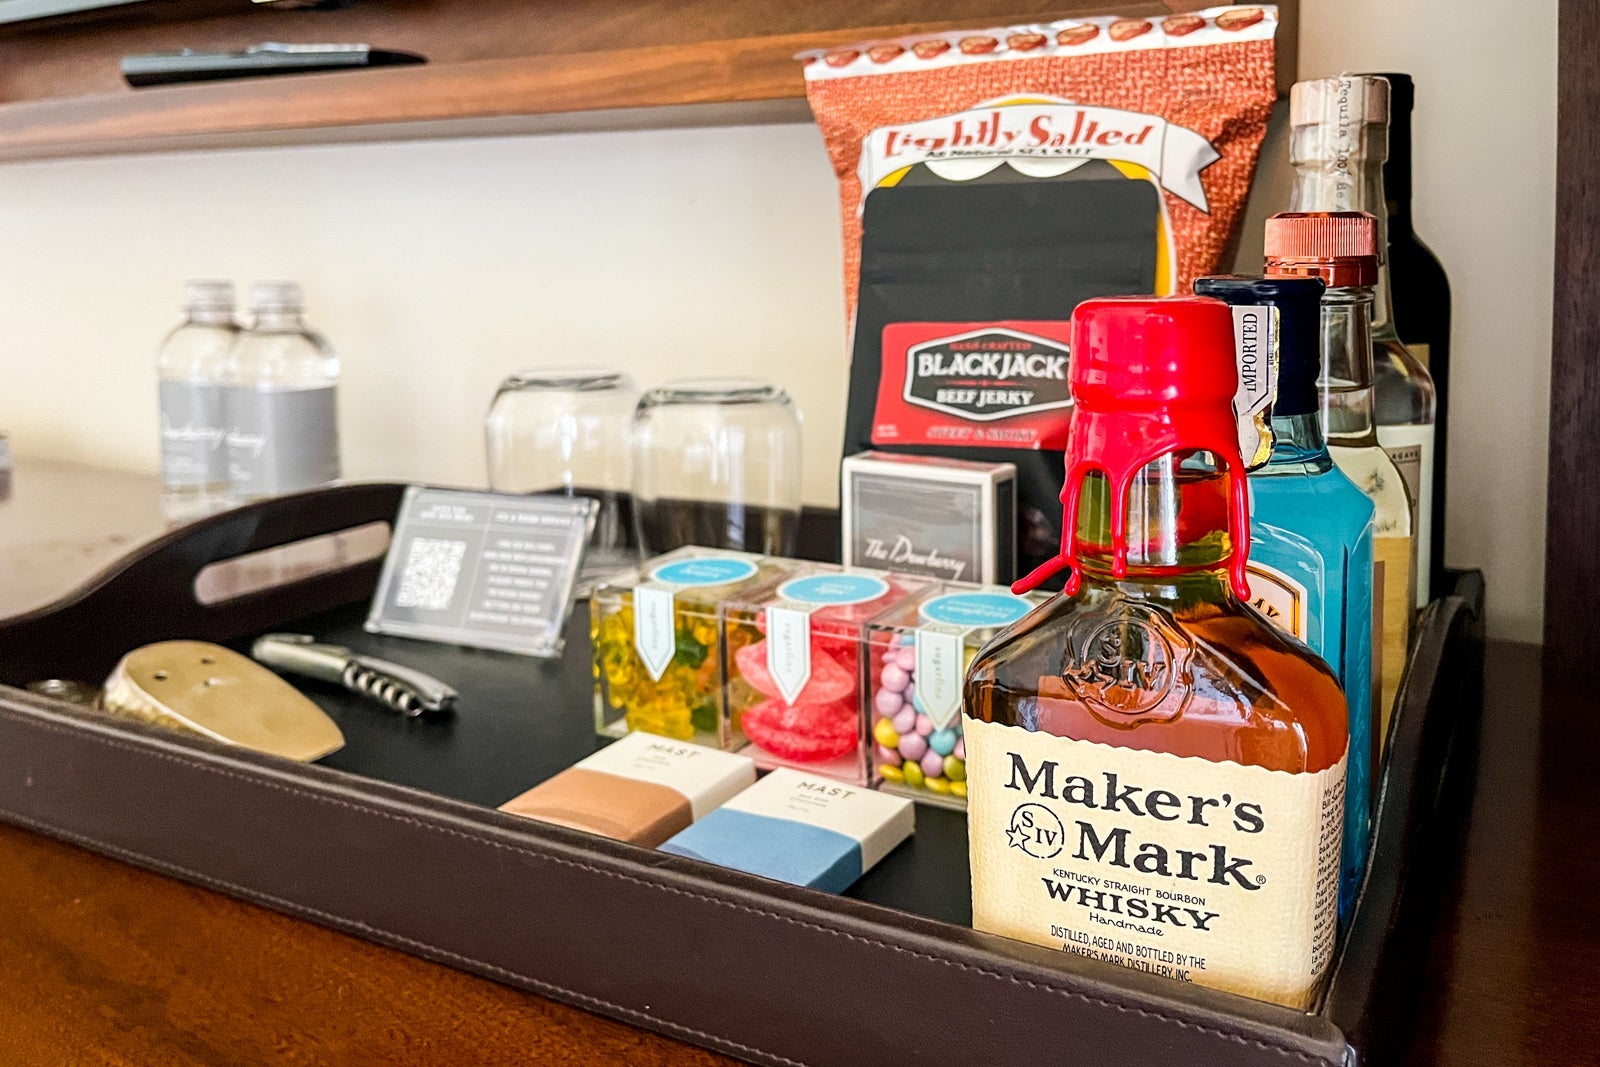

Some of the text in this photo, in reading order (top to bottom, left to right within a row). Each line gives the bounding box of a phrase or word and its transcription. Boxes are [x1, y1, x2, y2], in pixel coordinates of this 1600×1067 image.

[1338, 80, 1352, 138] Tequila
[884, 110, 1156, 159] Lightly Salted
[917, 352, 1066, 380] BLACKJACK
[1241, 313, 1258, 393] IMPORTED
[936, 389, 1035, 407] BEEF JERKY
[864, 537, 888, 558] The
[646, 743, 701, 759] MAST
[796, 781, 857, 799] MAST
[1003, 751, 1266, 834] Maker's
[1052, 867, 1206, 907] KENTUCKY STRAIGHT BOURBON
[1041, 877, 1220, 932] WHISKY
[1089, 911, 1165, 937] Handmade
[1051, 924, 1207, 970] DISTILLED, AGED AND BOTTLED BY THE
[1100, 952, 1126, 967] MARK
